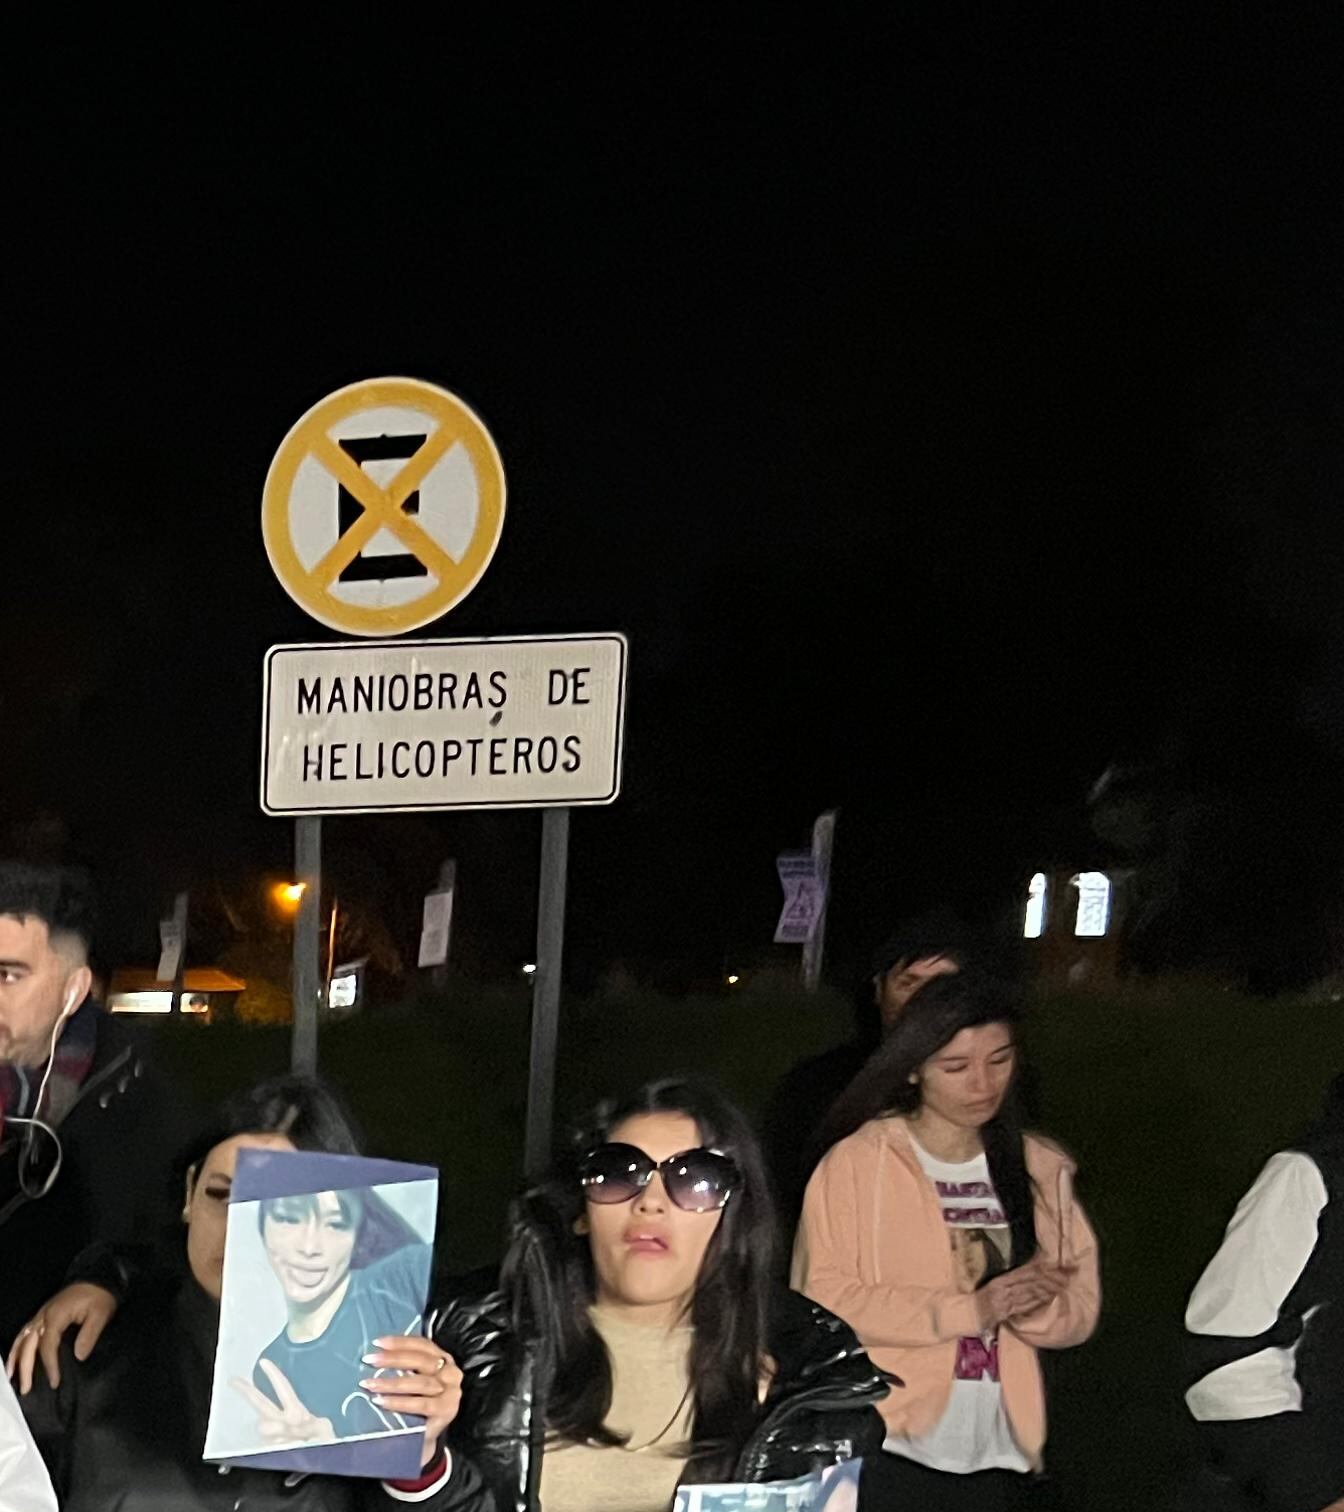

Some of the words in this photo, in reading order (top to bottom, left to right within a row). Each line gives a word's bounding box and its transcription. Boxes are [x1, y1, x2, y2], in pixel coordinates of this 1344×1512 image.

[297, 671, 508, 715] MANIOBRAS
[547, 668, 591, 705] DE
[302, 735, 582, 782] HELICOPTEROS
